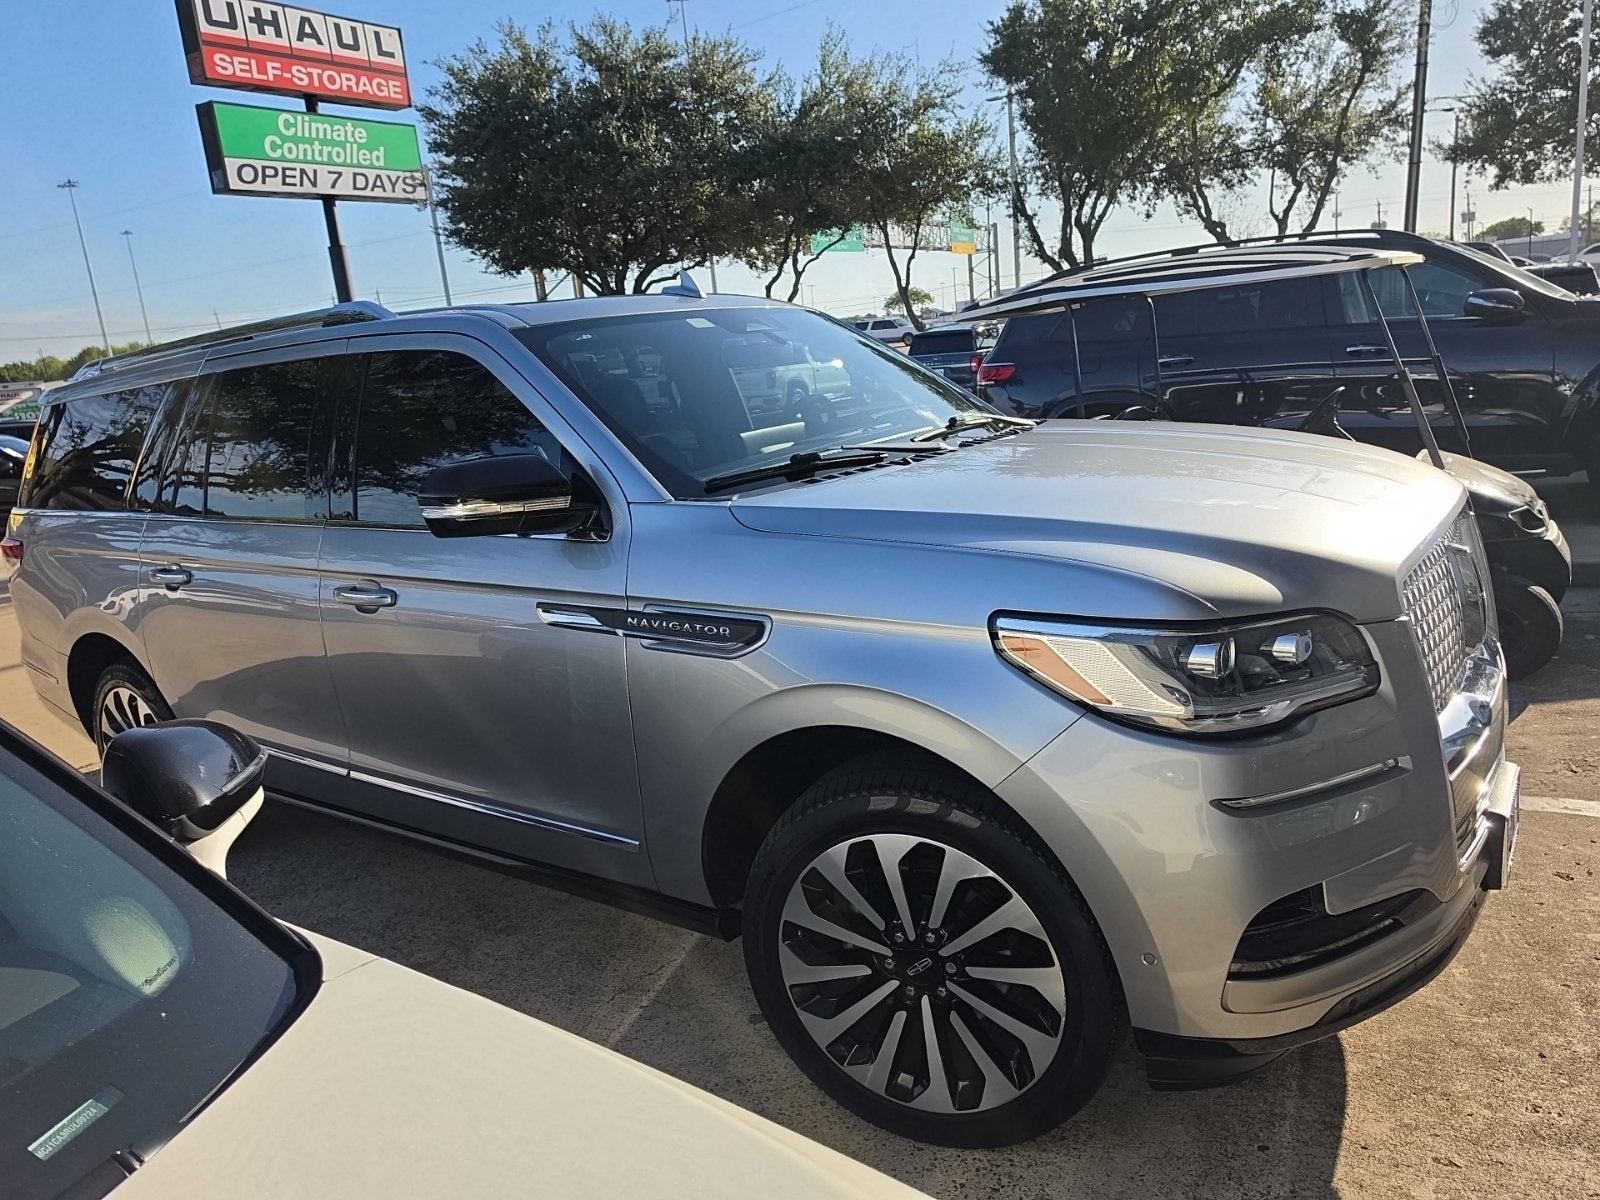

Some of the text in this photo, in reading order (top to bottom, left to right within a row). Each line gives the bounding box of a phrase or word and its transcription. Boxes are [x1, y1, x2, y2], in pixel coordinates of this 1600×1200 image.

[213, 53, 403, 99] SELF-STORAGE
[277, 114, 367, 143] Climate
[263, 136, 385, 167] Controlled
[236, 163, 417, 194] OPEN 7 DAYS
[626, 617, 732, 637] NAVIGATOR
